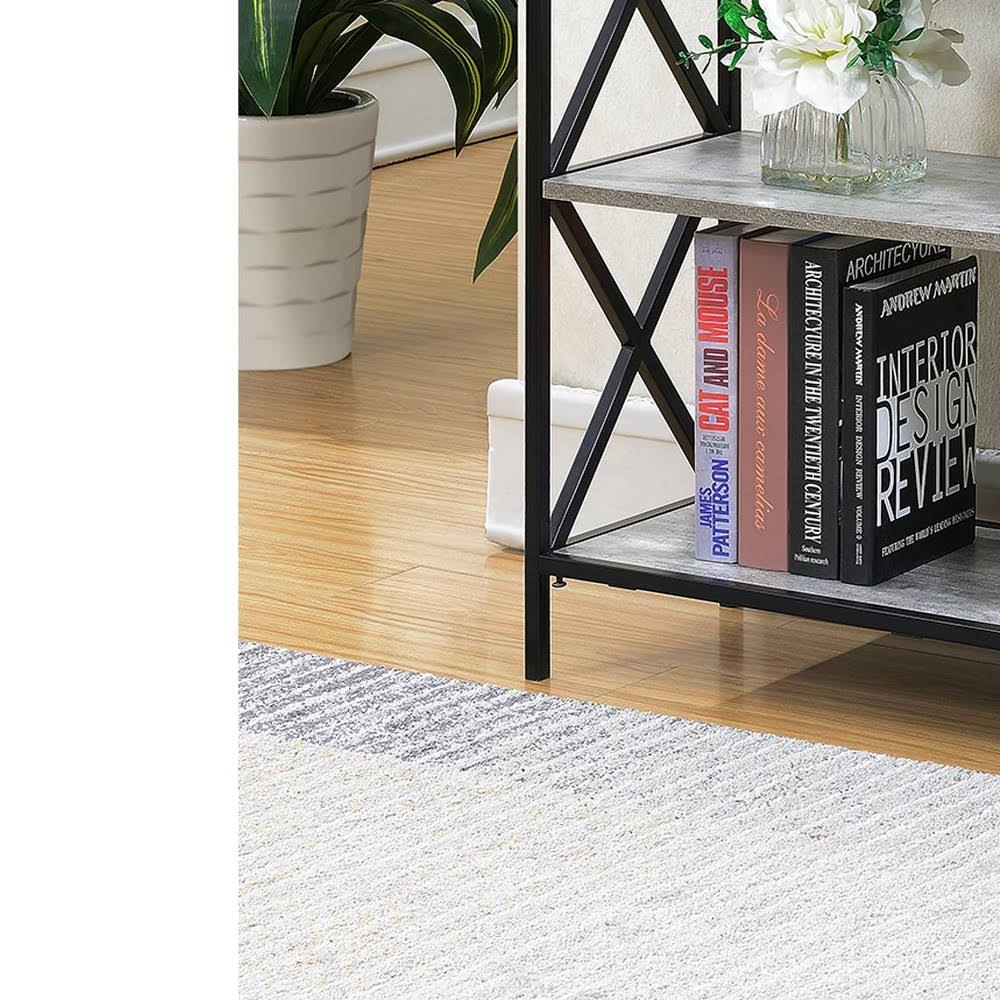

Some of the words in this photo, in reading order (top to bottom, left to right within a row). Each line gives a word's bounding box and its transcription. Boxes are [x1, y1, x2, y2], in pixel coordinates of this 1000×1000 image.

[697, 265, 729, 344] MOUSE
[756, 288, 780, 327] La
[880, 283, 932, 318] ANDREW
[933, 267, 977, 299] MARTIN
[855, 303, 863, 347] ANDREW
[703, 348, 729, 387] AND
[756, 332, 776, 391] dame
[804, 361, 823, 377] IN
[876, 321, 976, 402] INTERIOR
[698, 389, 730, 433] CAT
[804, 379, 823, 405] THE
[855, 394, 863, 433] INTERIOR
[755, 395, 768, 437] aux
[876, 367, 976, 463] DESIGN
[804, 406, 823, 482] TWENTIETH
[855, 435, 863, 466] DESIGN
[855, 468, 863, 500] REVIEW
[876, 428, 976, 527] REVIEW
[699, 487, 712, 529] JAMES
[712, 459, 729, 558] PATTERSON
[803, 483, 823, 544] CENTURY
